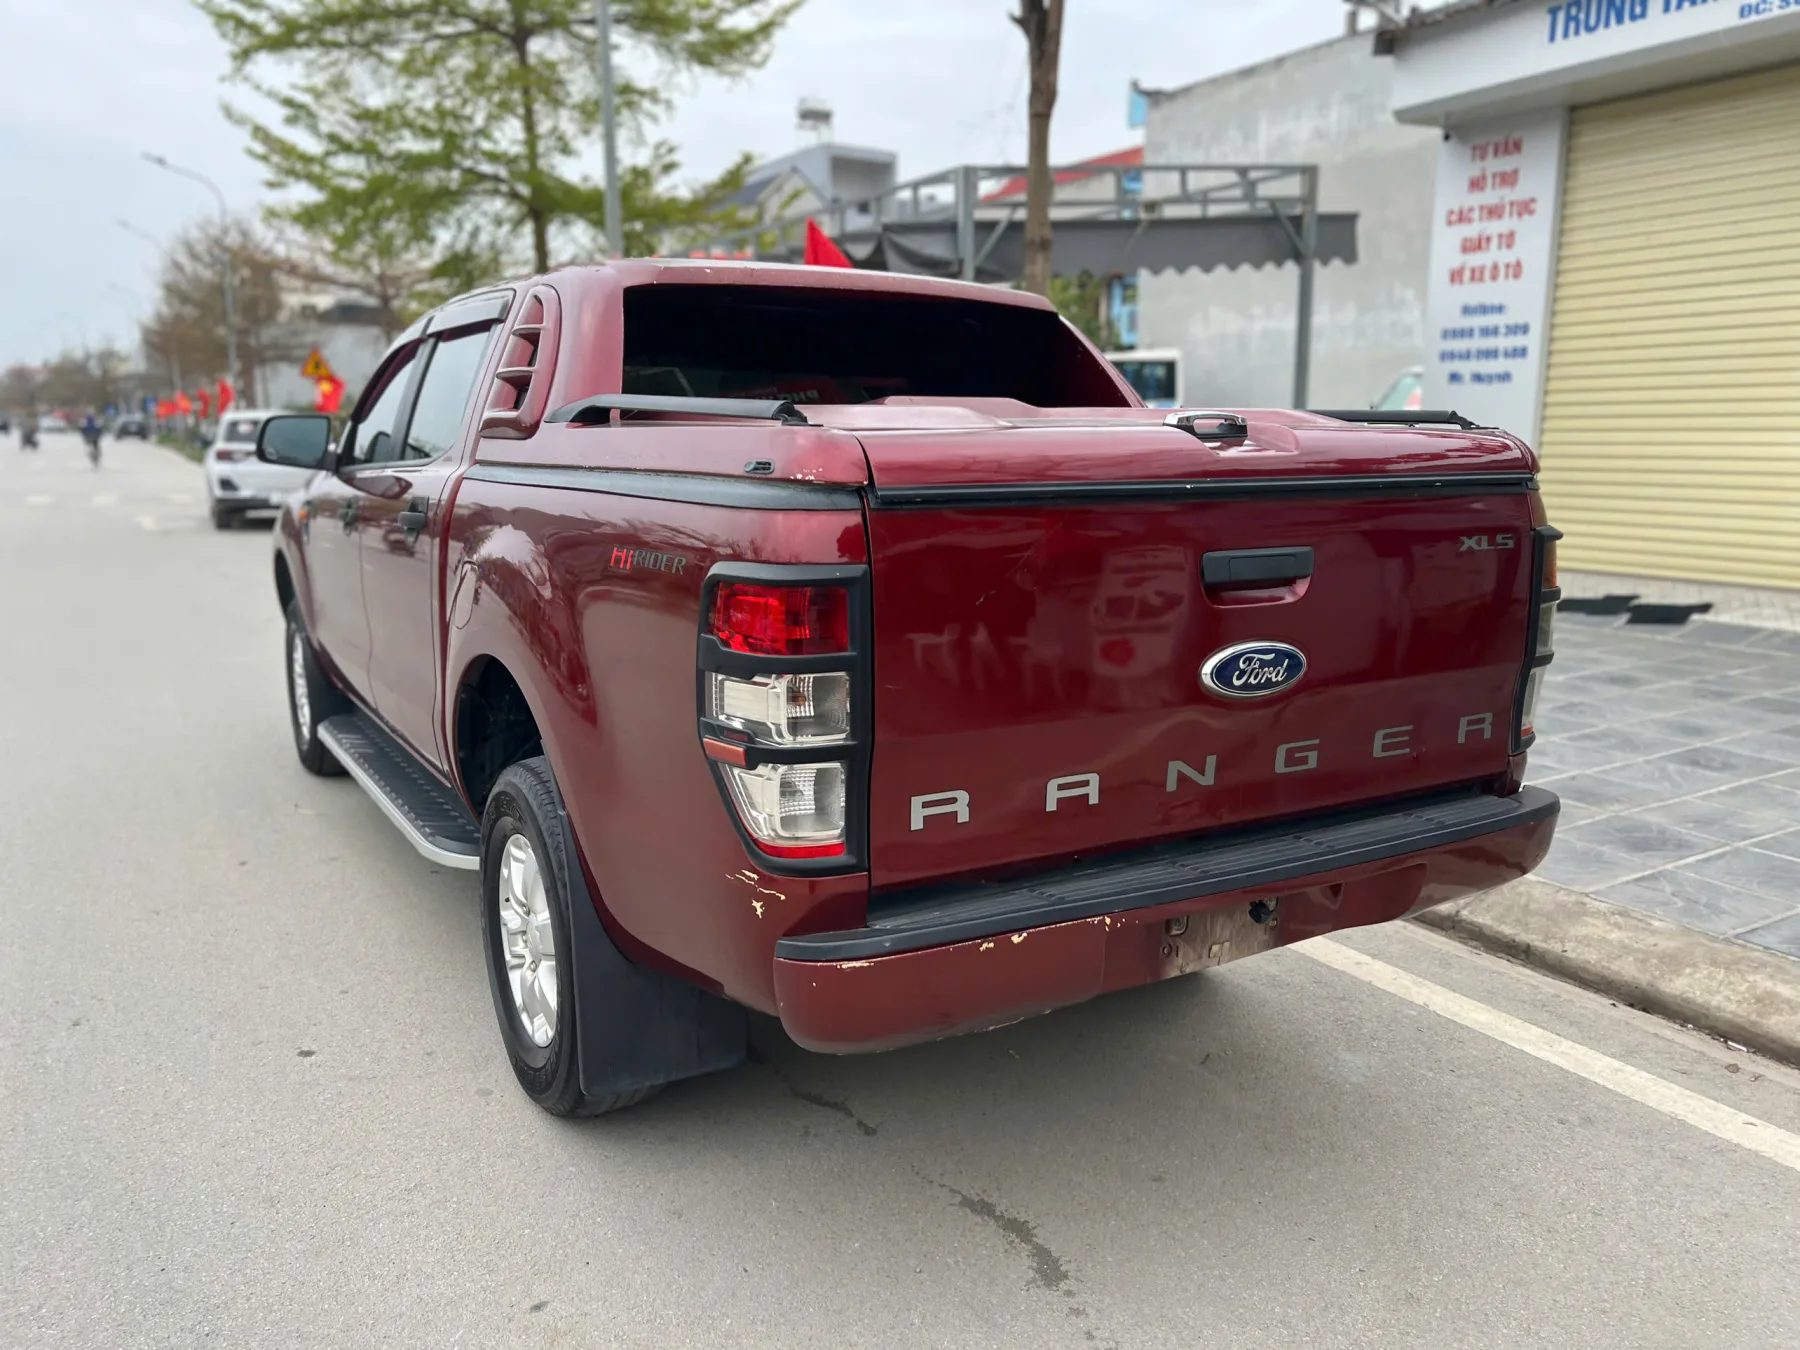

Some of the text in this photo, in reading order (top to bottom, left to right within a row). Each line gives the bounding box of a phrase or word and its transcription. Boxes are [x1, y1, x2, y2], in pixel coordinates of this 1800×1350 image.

[1547, 0, 1648, 43] TRUNG
[1459, 534, 1515, 551] XLS
[1232, 653, 1289, 686] Ford
[910, 711, 1493, 831] RANGER
